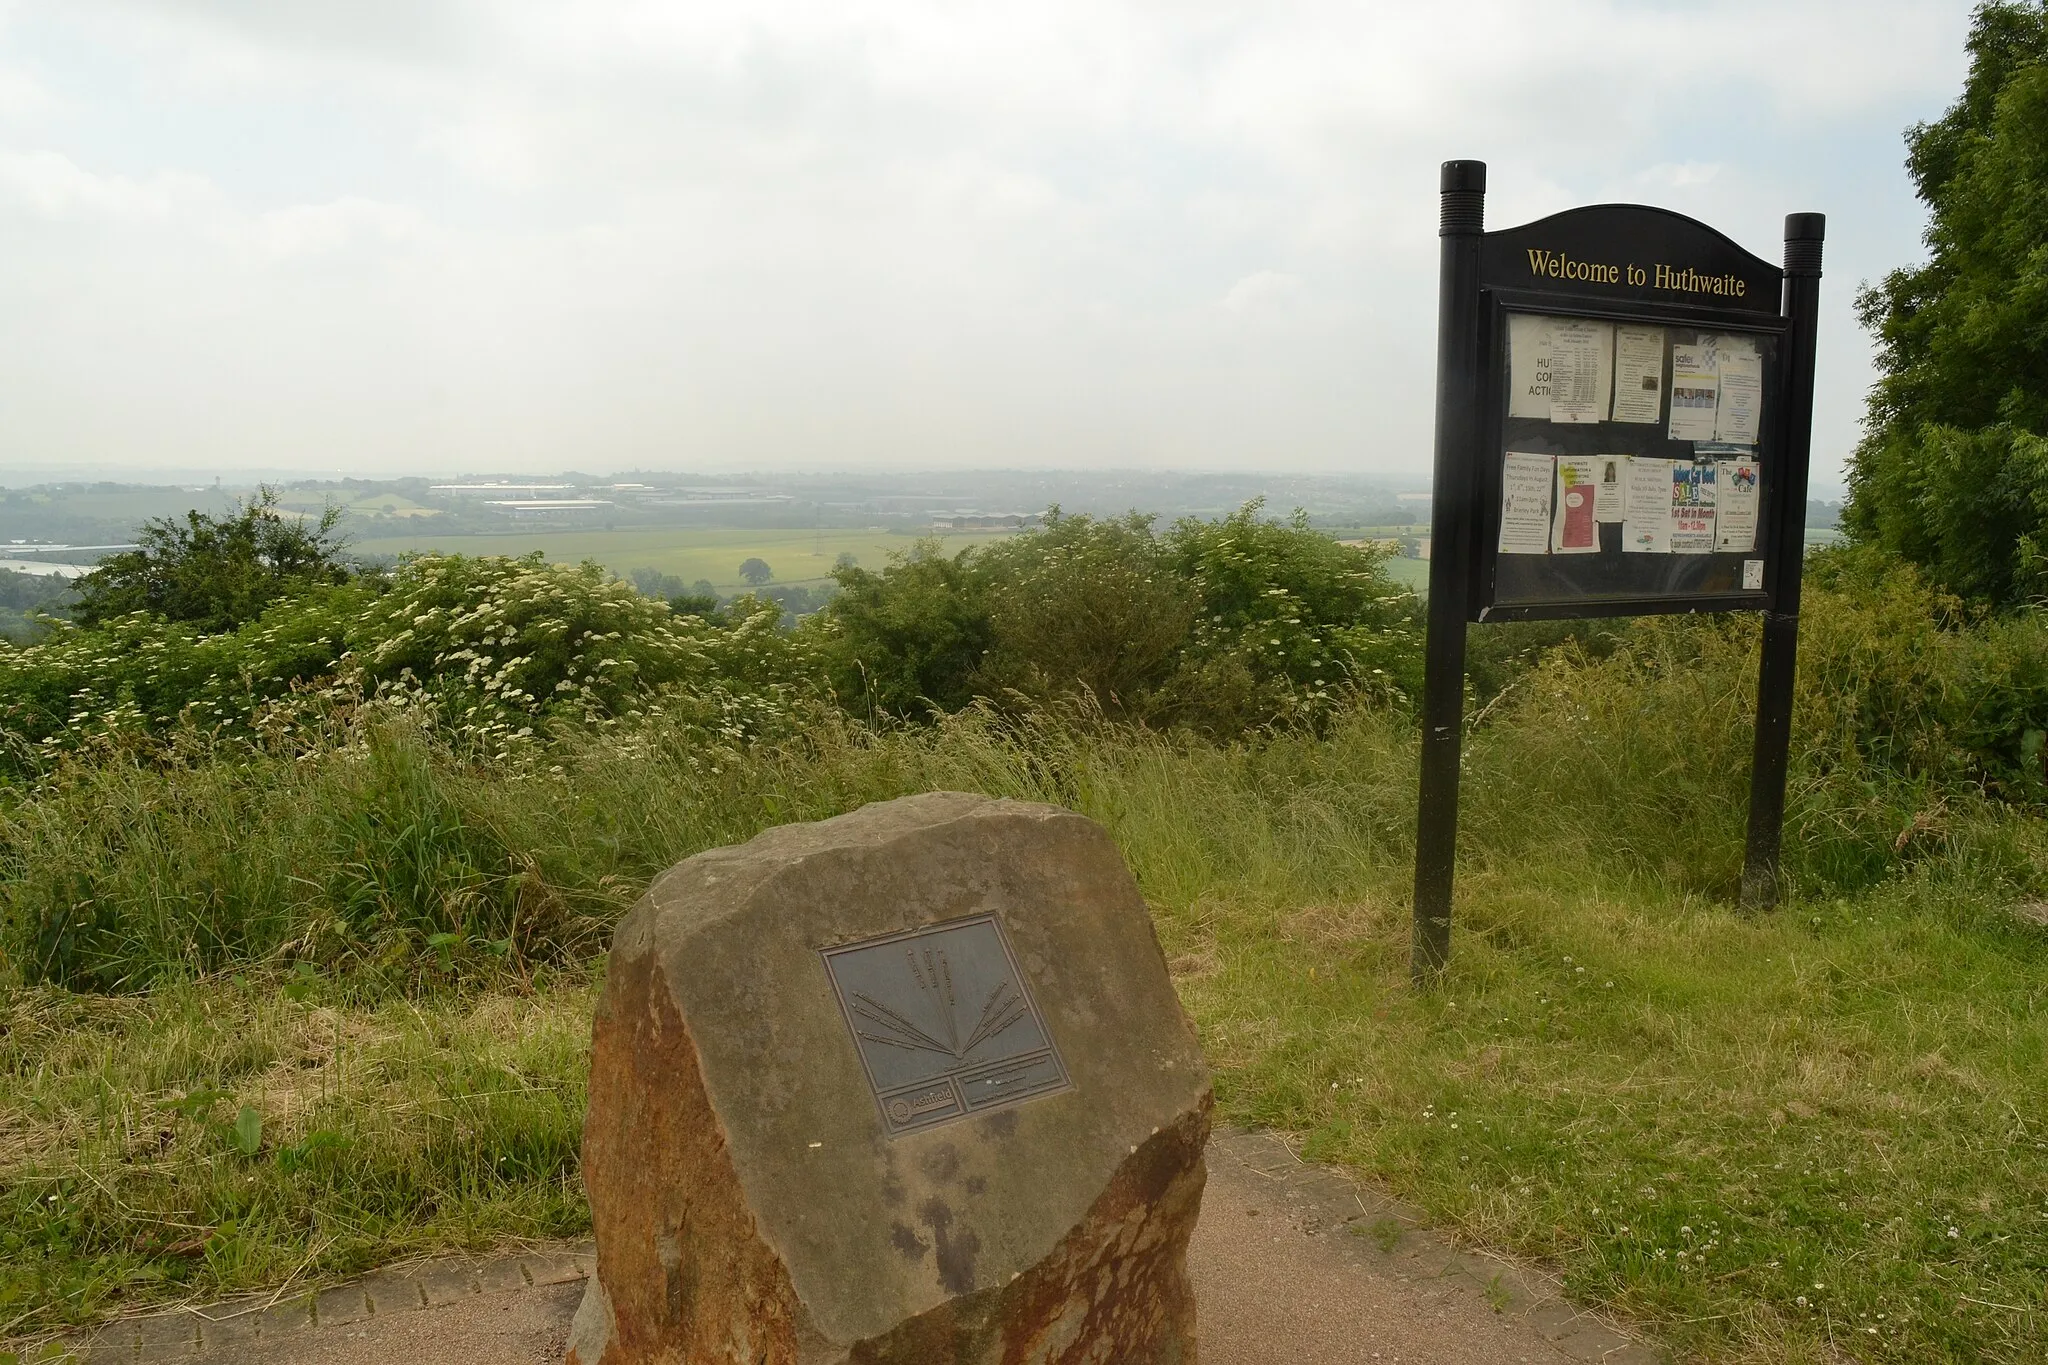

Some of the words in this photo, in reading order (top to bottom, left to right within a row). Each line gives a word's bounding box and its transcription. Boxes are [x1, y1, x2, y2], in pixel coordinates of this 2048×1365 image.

[1526, 248, 1620, 284] Welcome
[1626, 262, 1647, 287] to
[1653, 263, 1746, 298] Huthwaite
[1675, 353, 1693, 364] safer
[1536, 372, 1552, 382] CO
[1506, 463, 1517, 471] Free
[1517, 464, 1531, 473] Family
[1721, 467, 1732, 476] The
[1673, 484, 1698, 501] SALE
[1737, 484, 1753, 493] Cafe
[1671, 507, 1680, 518] 1st
[1680, 507, 1690, 518] Sat
[1690, 507, 1697, 518] in
[1697, 507, 1715, 519] Month
[912, 1088, 953, 1109] Ashfield
